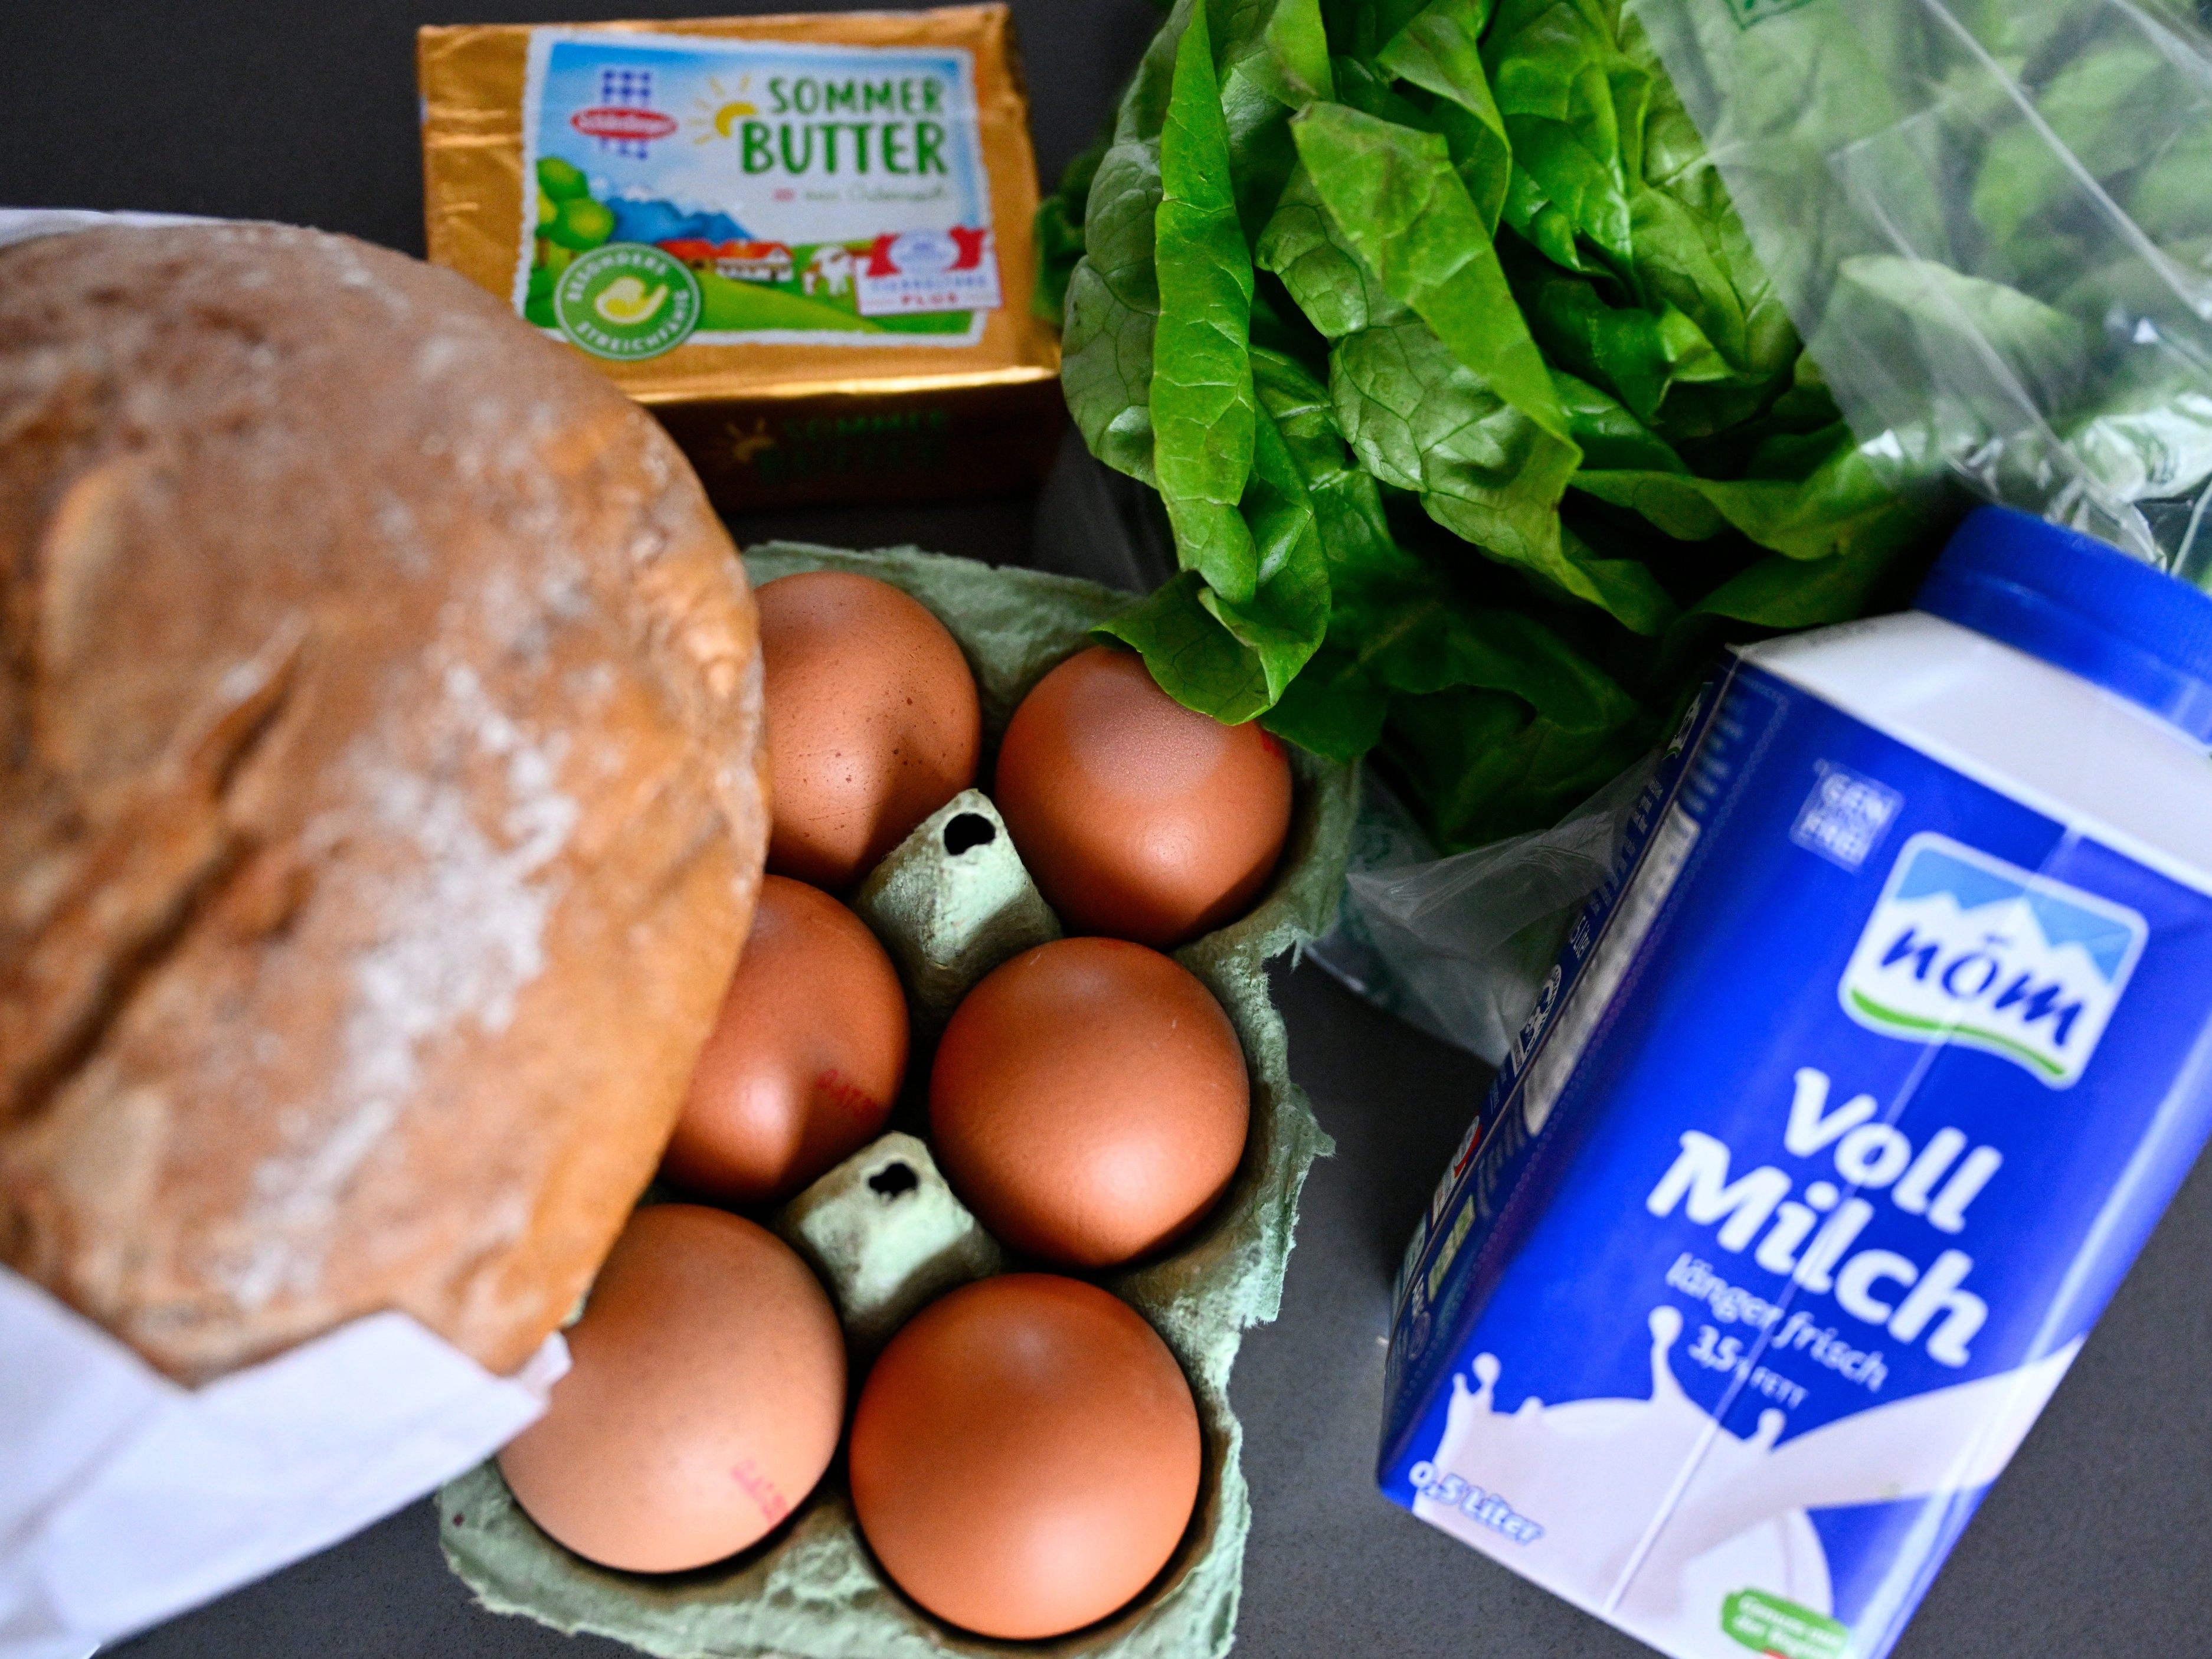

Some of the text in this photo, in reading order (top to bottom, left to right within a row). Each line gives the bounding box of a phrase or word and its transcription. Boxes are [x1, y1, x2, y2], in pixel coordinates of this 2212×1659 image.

[768, 77, 944, 115] SOMMER
[741, 121, 948, 175] BUTTER
[1784, 1066, 2004, 1235] Voll
[1645, 1129, 1989, 1369] Milch
[1771, 1311, 1889, 1393] frisch
[1459, 1485, 1546, 1546] Liter
